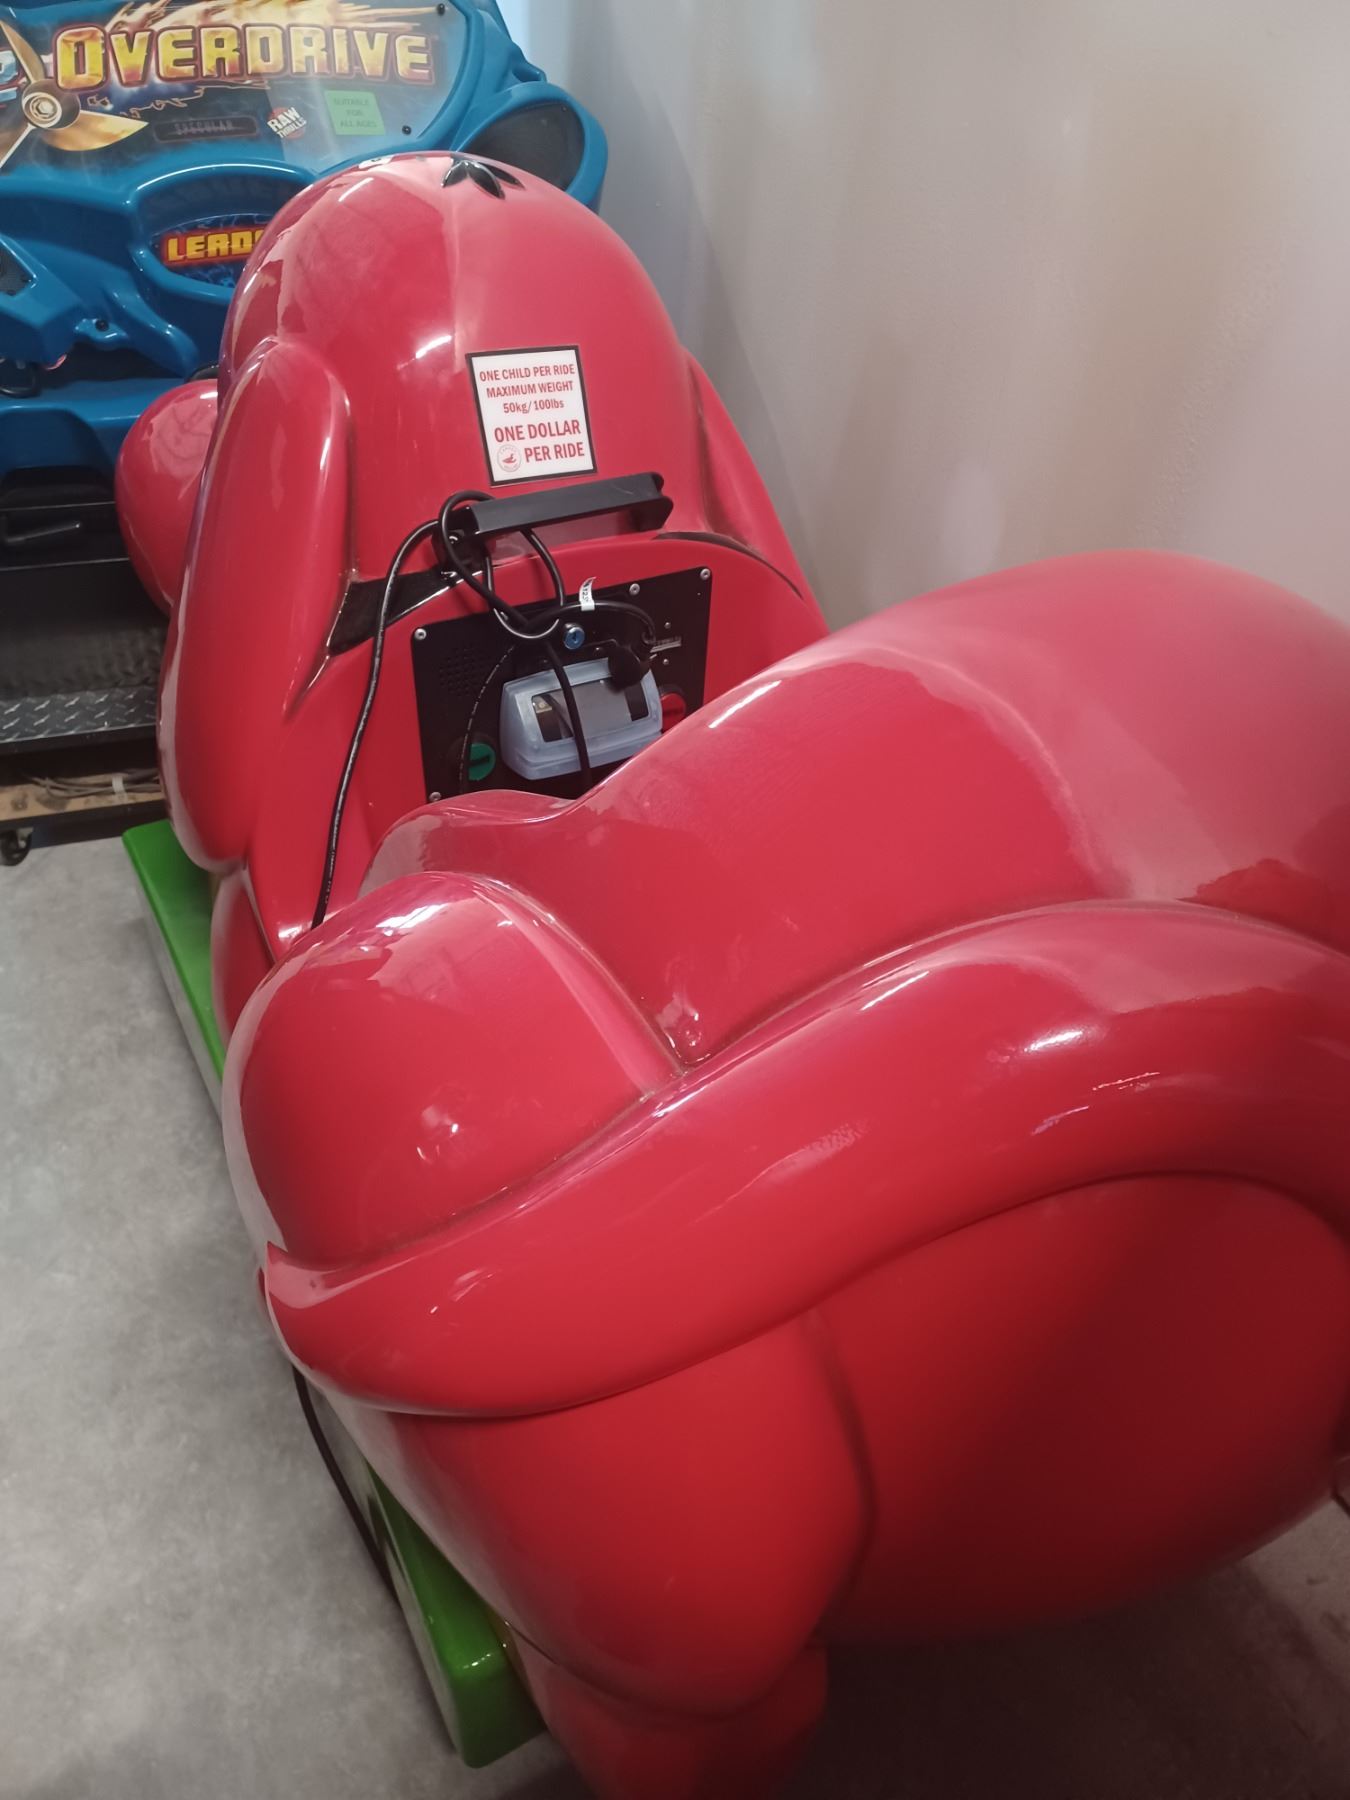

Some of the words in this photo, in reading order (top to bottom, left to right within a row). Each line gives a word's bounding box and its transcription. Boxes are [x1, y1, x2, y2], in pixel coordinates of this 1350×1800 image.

[54, 24, 433, 90] OVERDRIVE
[267, 106, 301, 132] RAW
[480, 369, 500, 382] ONE
[502, 367, 531, 380] CHILD
[533, 365, 552, 377] PER
[554, 363, 575, 376] RIDE
[486, 383, 537, 398] MAXIMUM
[538, 380, 573, 393] WEIGHT
[494, 425, 525, 443] ONE
[527, 419, 581, 439] DOLLAR
[524, 445, 552, 463] PER
[554, 442, 585, 459] RIDE
